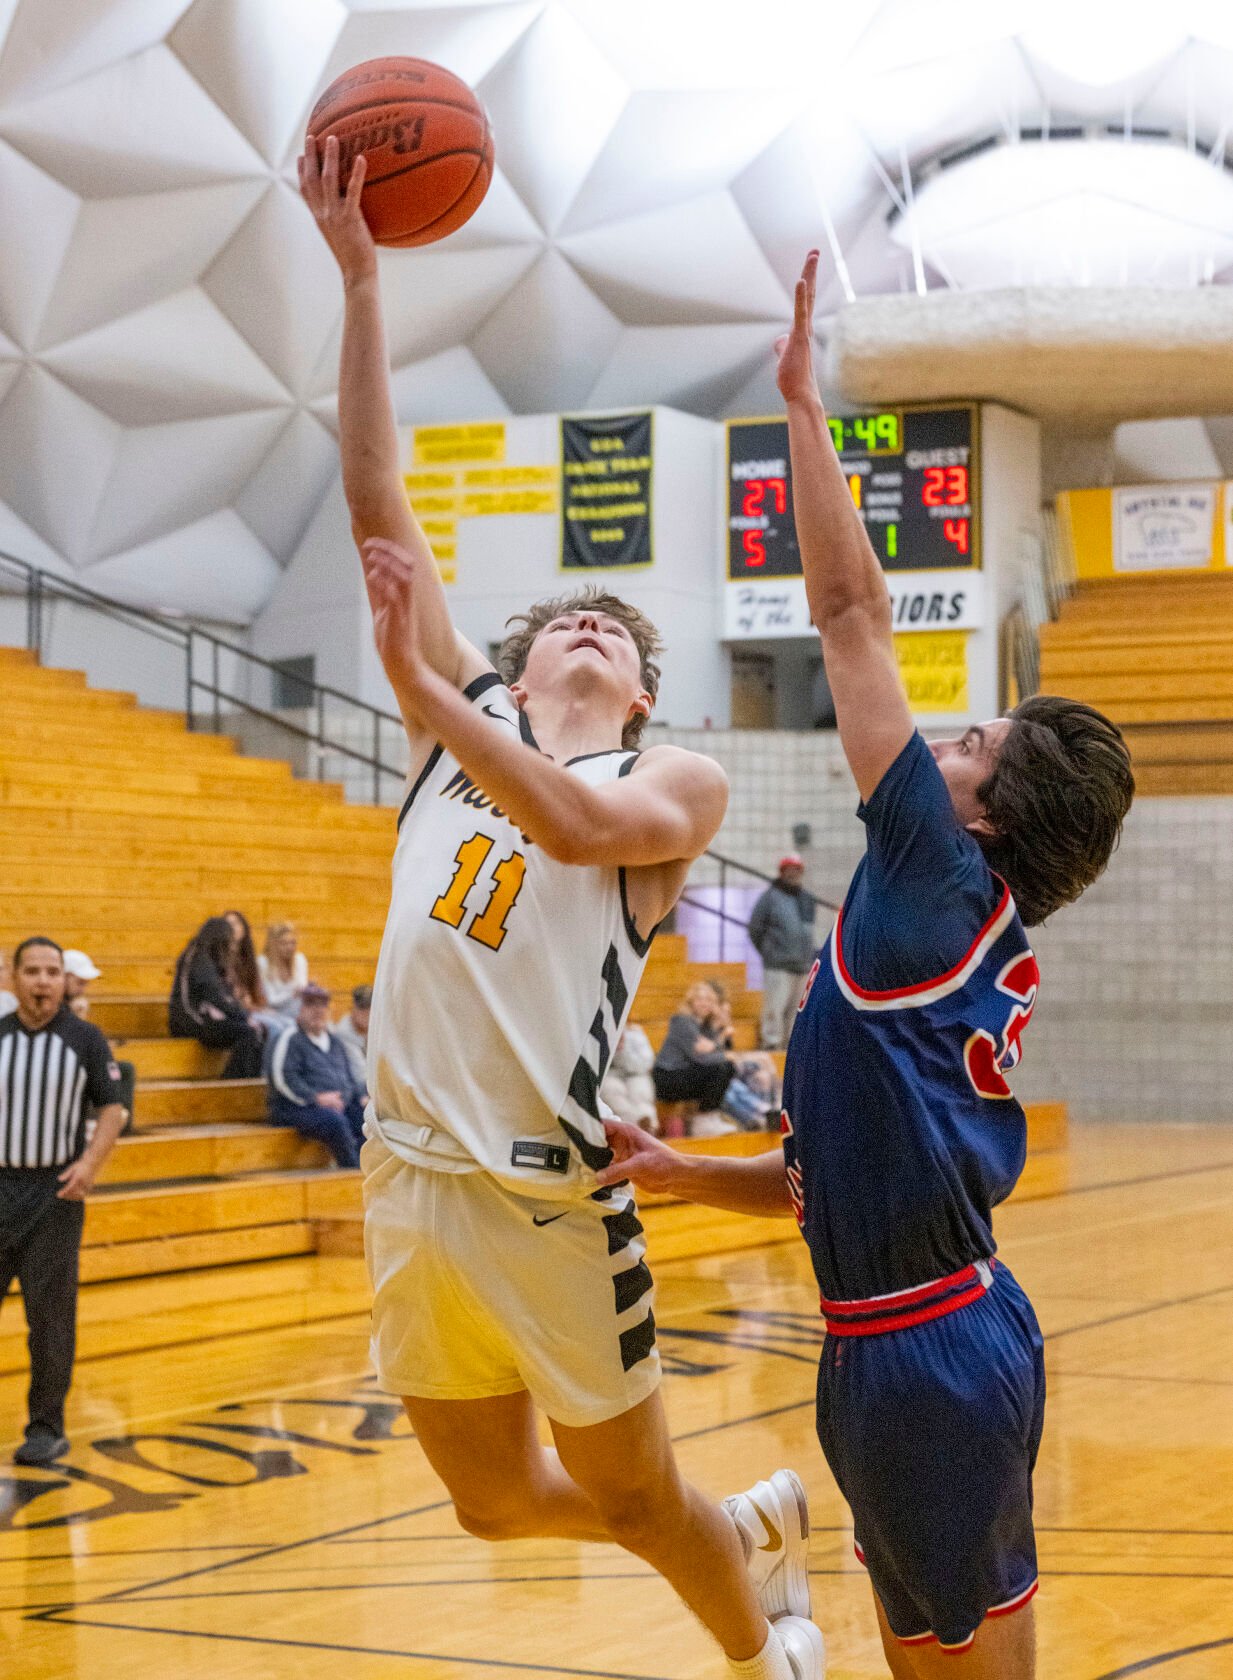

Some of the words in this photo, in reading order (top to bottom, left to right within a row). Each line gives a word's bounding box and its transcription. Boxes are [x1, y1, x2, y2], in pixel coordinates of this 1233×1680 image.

[732, 459, 786, 480] HOME
[905, 447, 969, 470] GUEST
[743, 478, 786, 517] 27
[922, 466, 968, 507] 23
[743, 529, 766, 566] 5
[886, 524, 897, 557] 1
[943, 518, 968, 554] 4
[889, 590, 966, 623] IORS
[429, 831, 526, 952] 11
